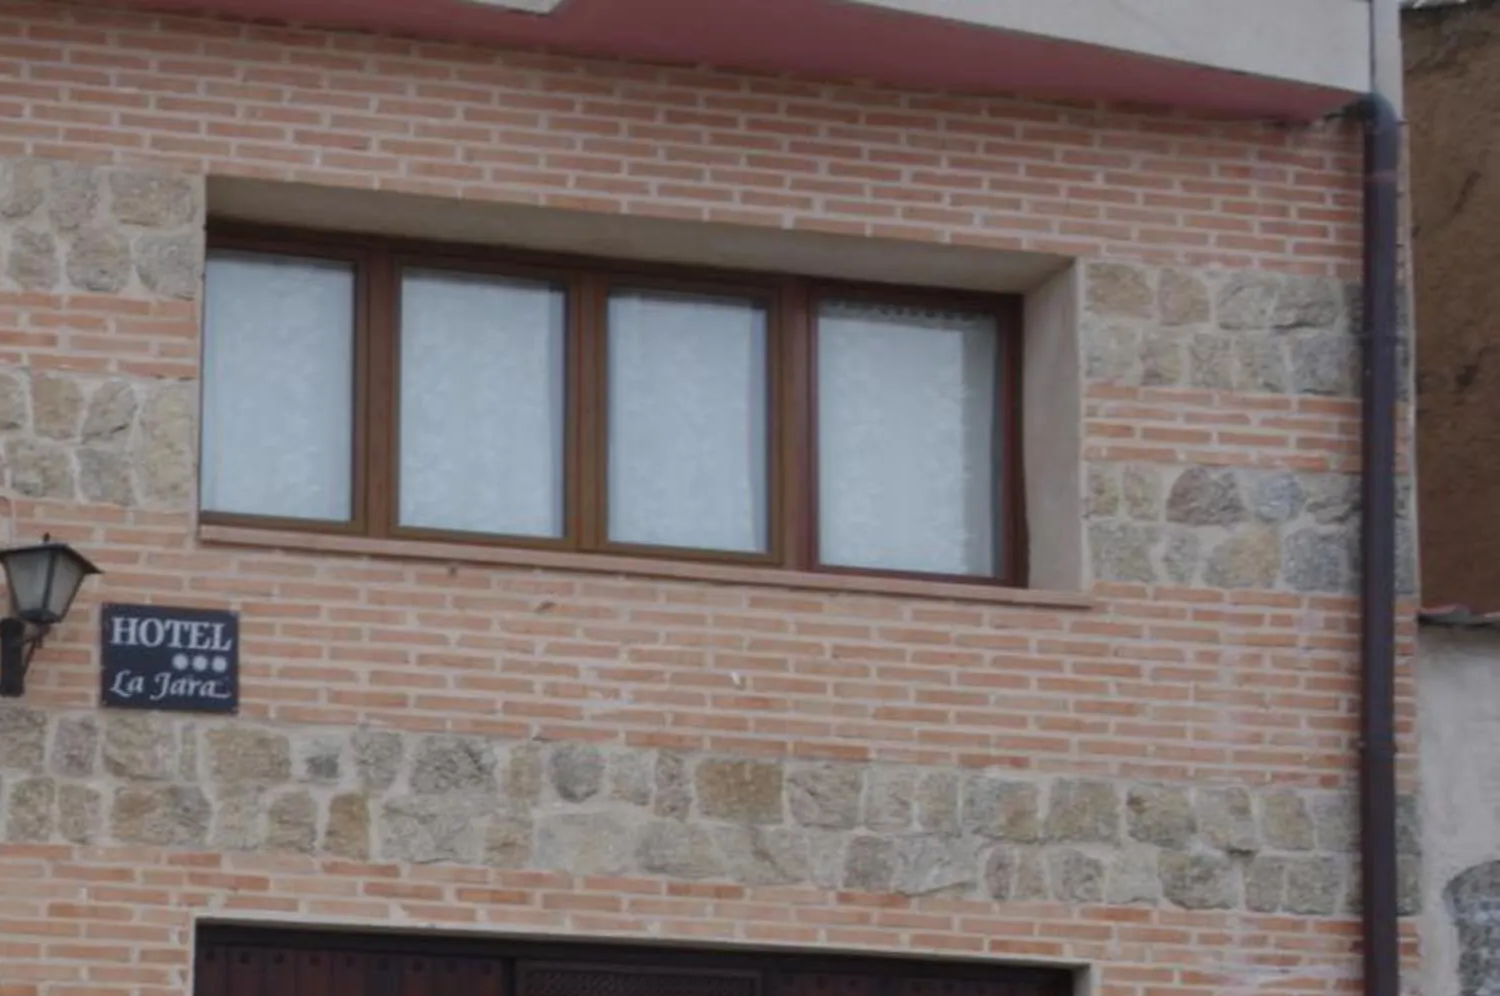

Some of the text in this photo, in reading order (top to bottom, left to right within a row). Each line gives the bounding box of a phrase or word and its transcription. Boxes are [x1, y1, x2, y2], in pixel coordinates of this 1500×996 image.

[110, 617, 232, 651] HOTEL
[109, 670, 231, 700] La Jara
